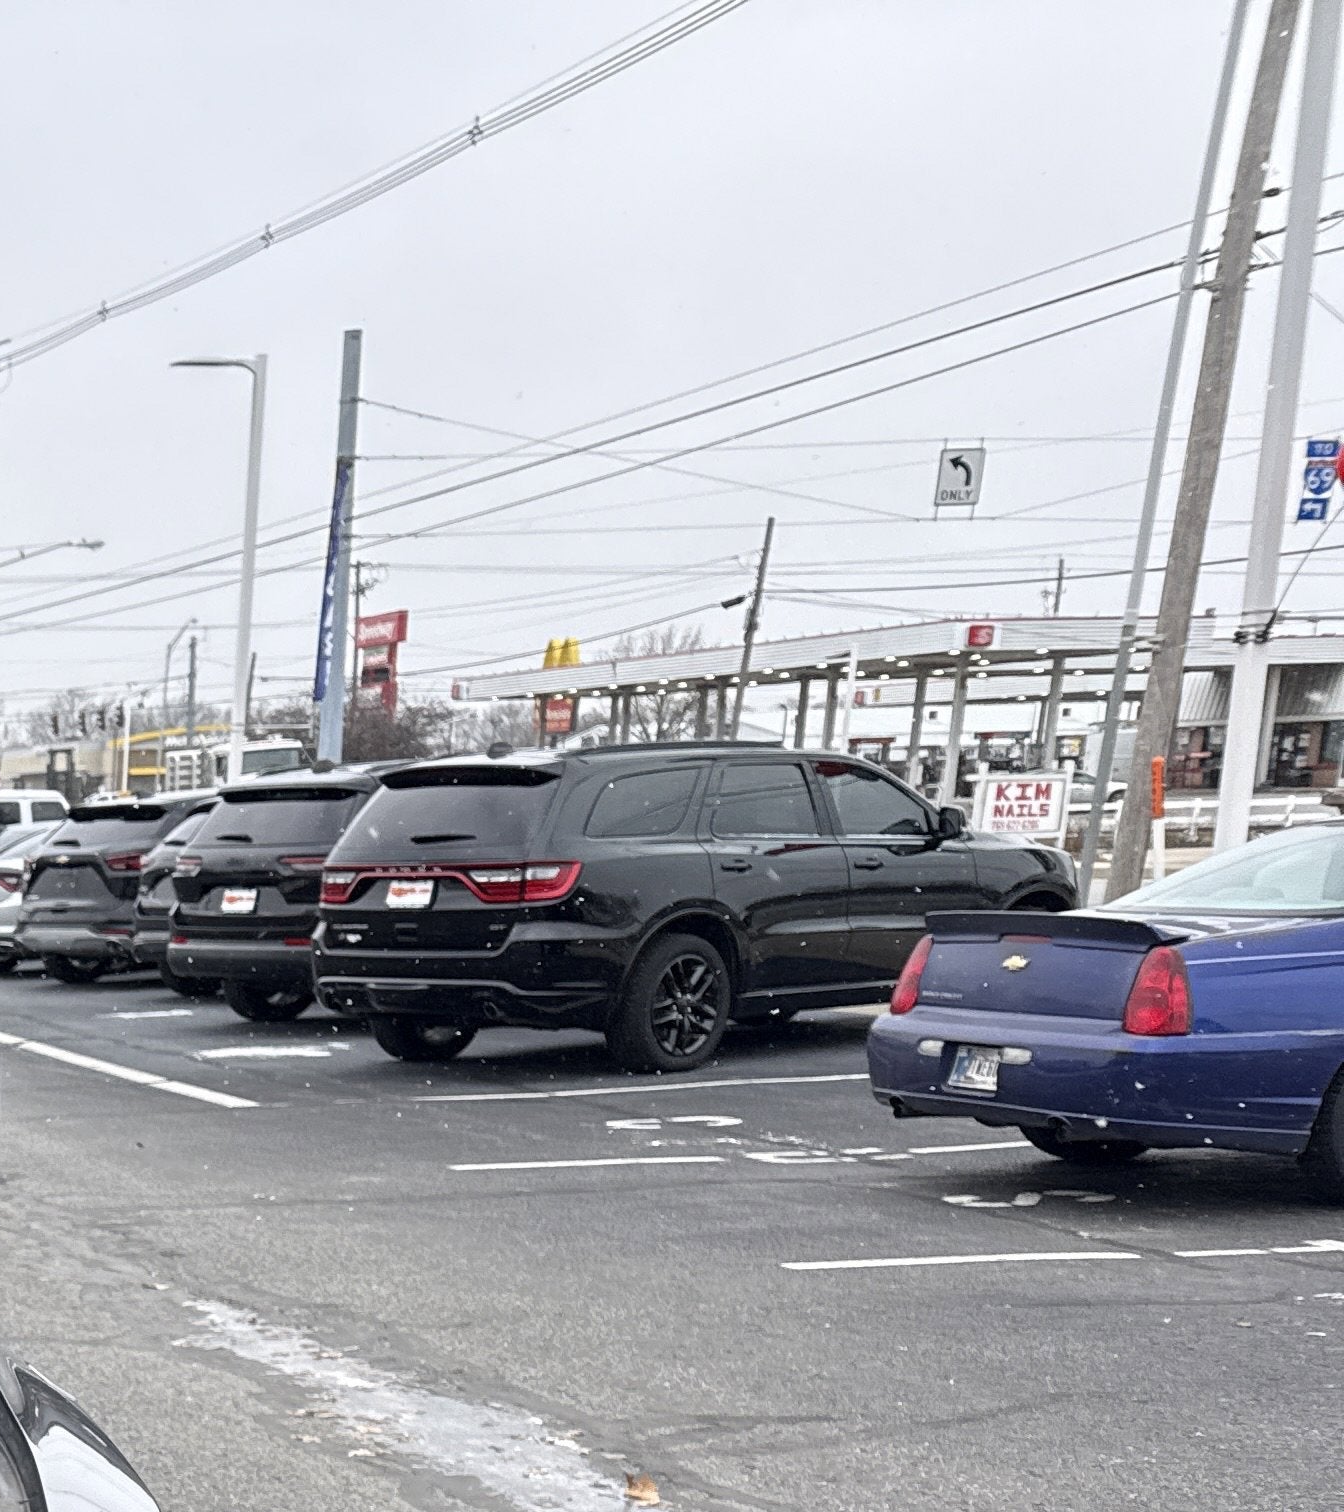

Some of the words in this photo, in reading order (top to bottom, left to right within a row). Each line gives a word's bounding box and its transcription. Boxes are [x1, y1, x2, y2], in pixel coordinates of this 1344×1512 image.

[1307, 467, 1335, 490] 69
[940, 489, 973, 501] ONLY
[996, 783, 1053, 801] KIM
[993, 804, 1050, 818] NAILS
